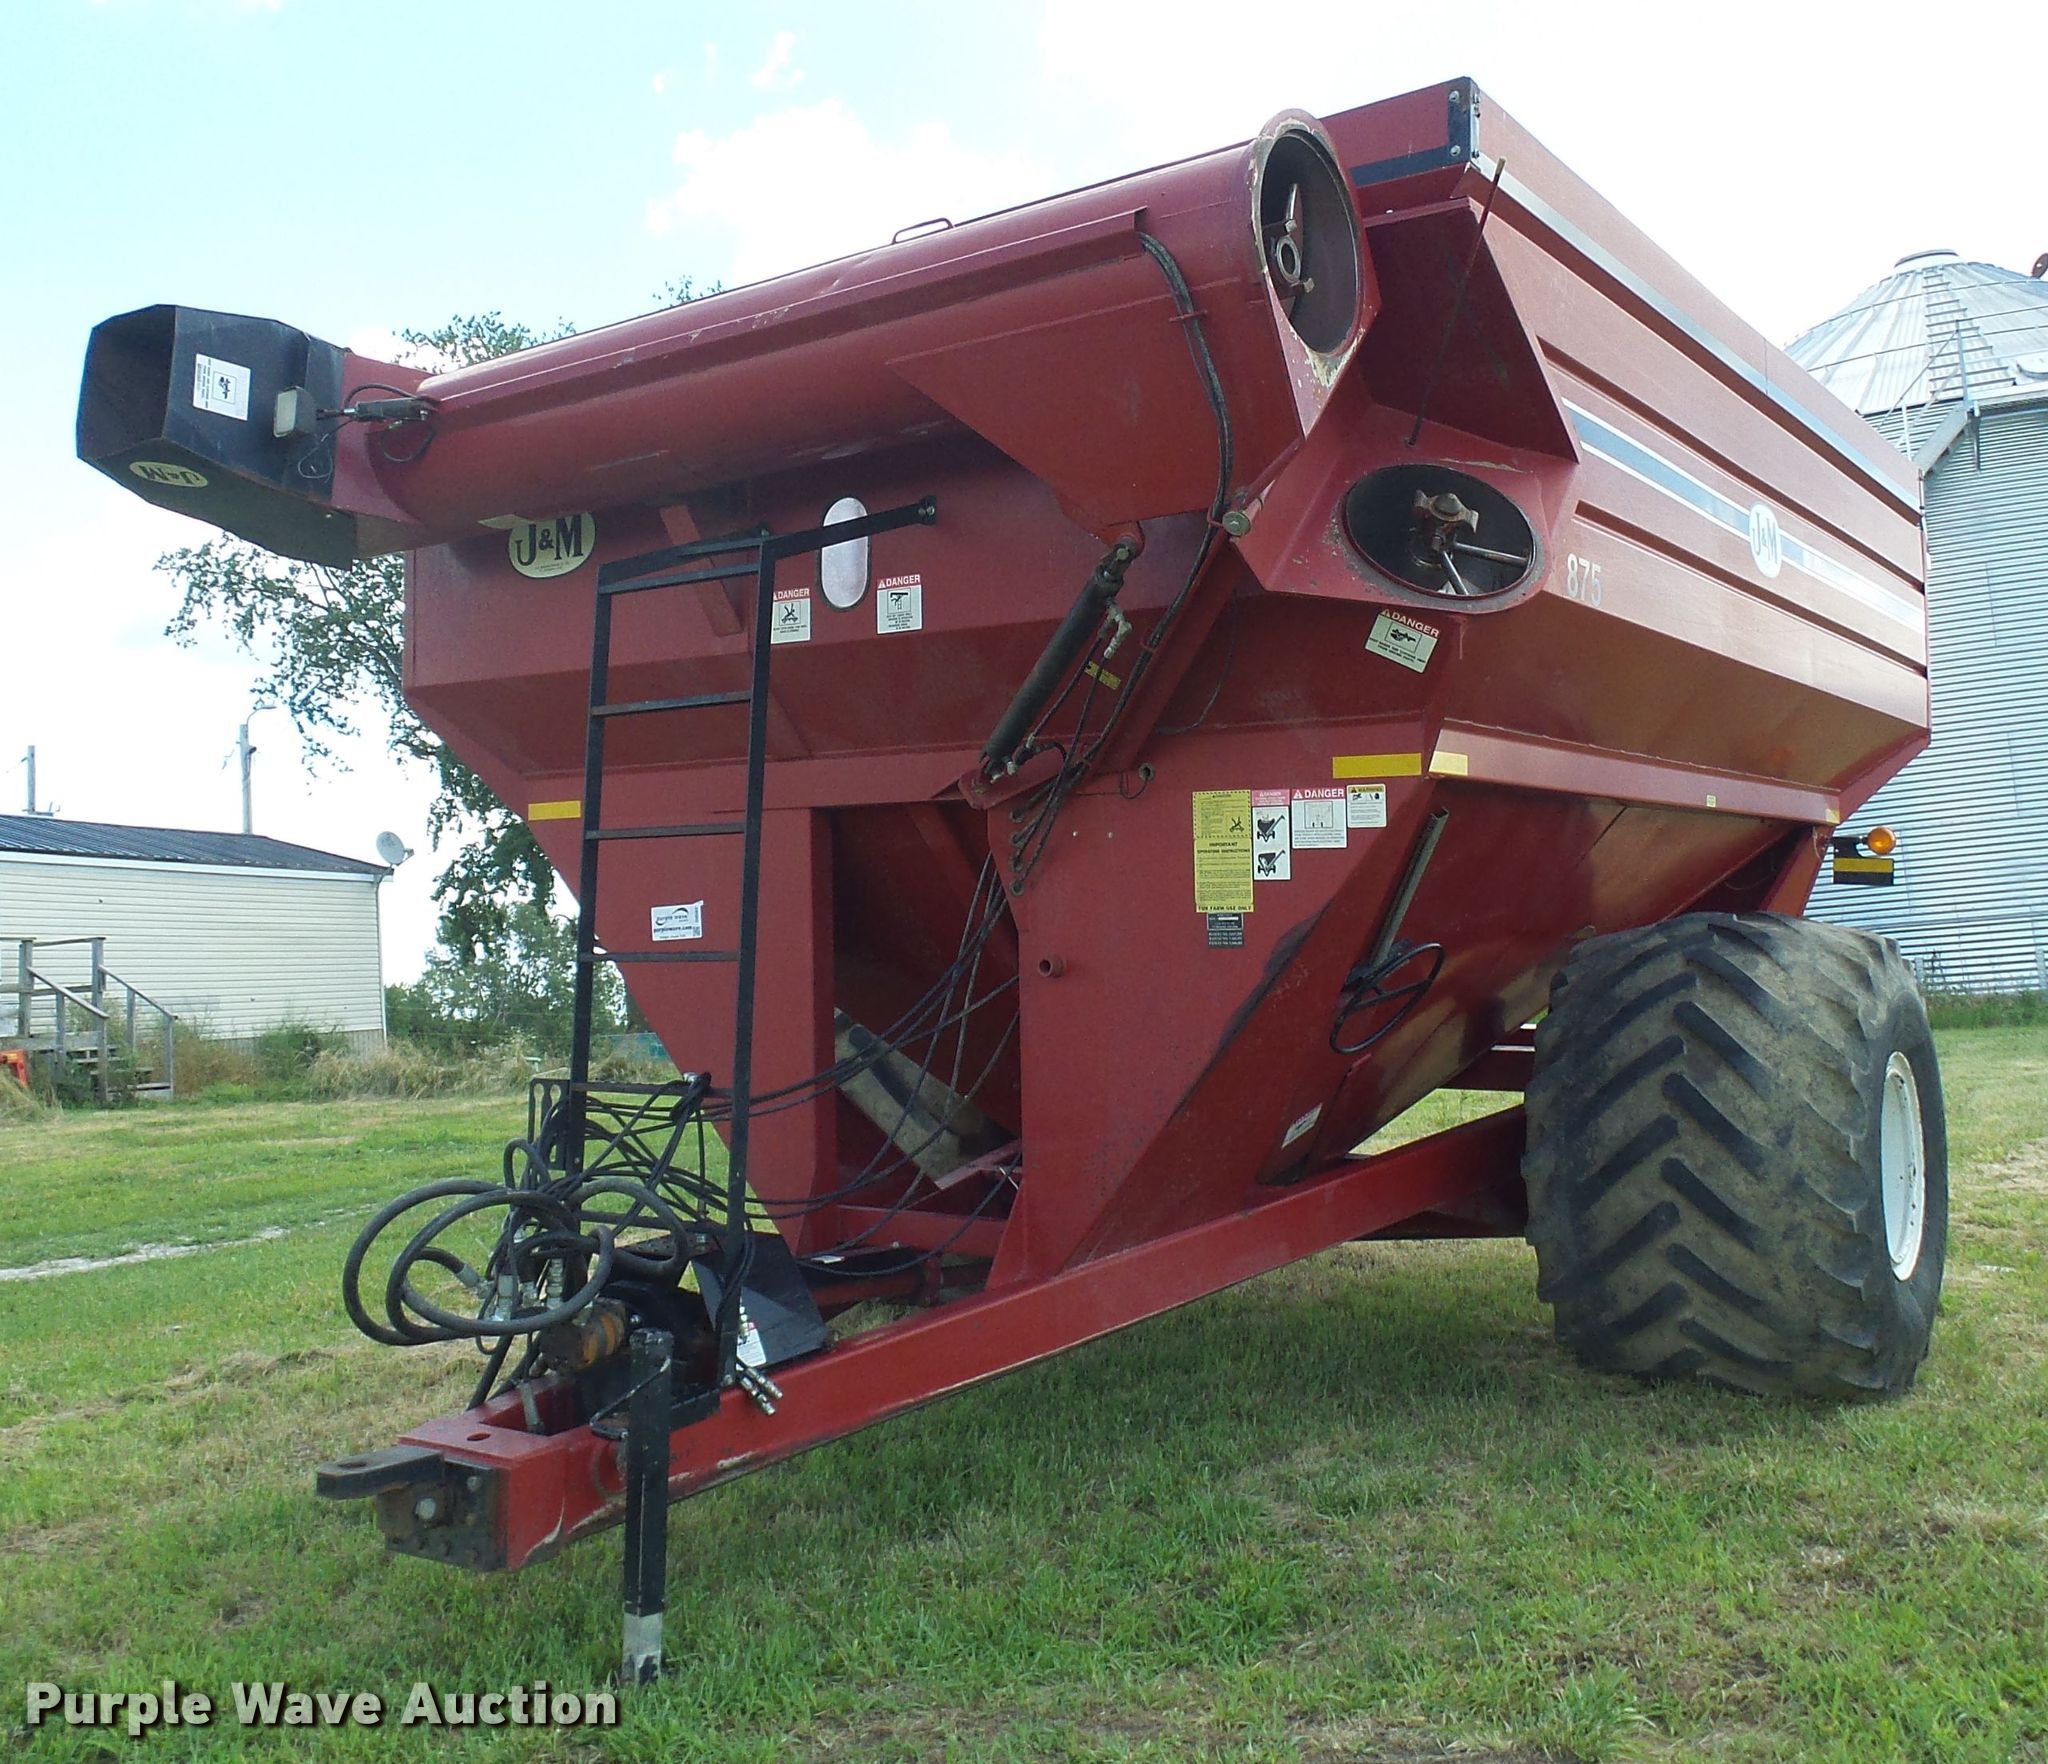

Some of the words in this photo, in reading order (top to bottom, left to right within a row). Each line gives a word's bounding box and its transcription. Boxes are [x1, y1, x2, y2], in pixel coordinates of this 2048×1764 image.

[515, 514, 584, 567] J&M
[1752, 511, 1778, 565] J&M
[885, 574, 921, 587] DANGER
[1567, 552, 1603, 607] 875
[777, 587, 810, 600] DANGER
[1391, 611, 1440, 638] DANGER
[1304, 788, 1345, 799] DANGER
